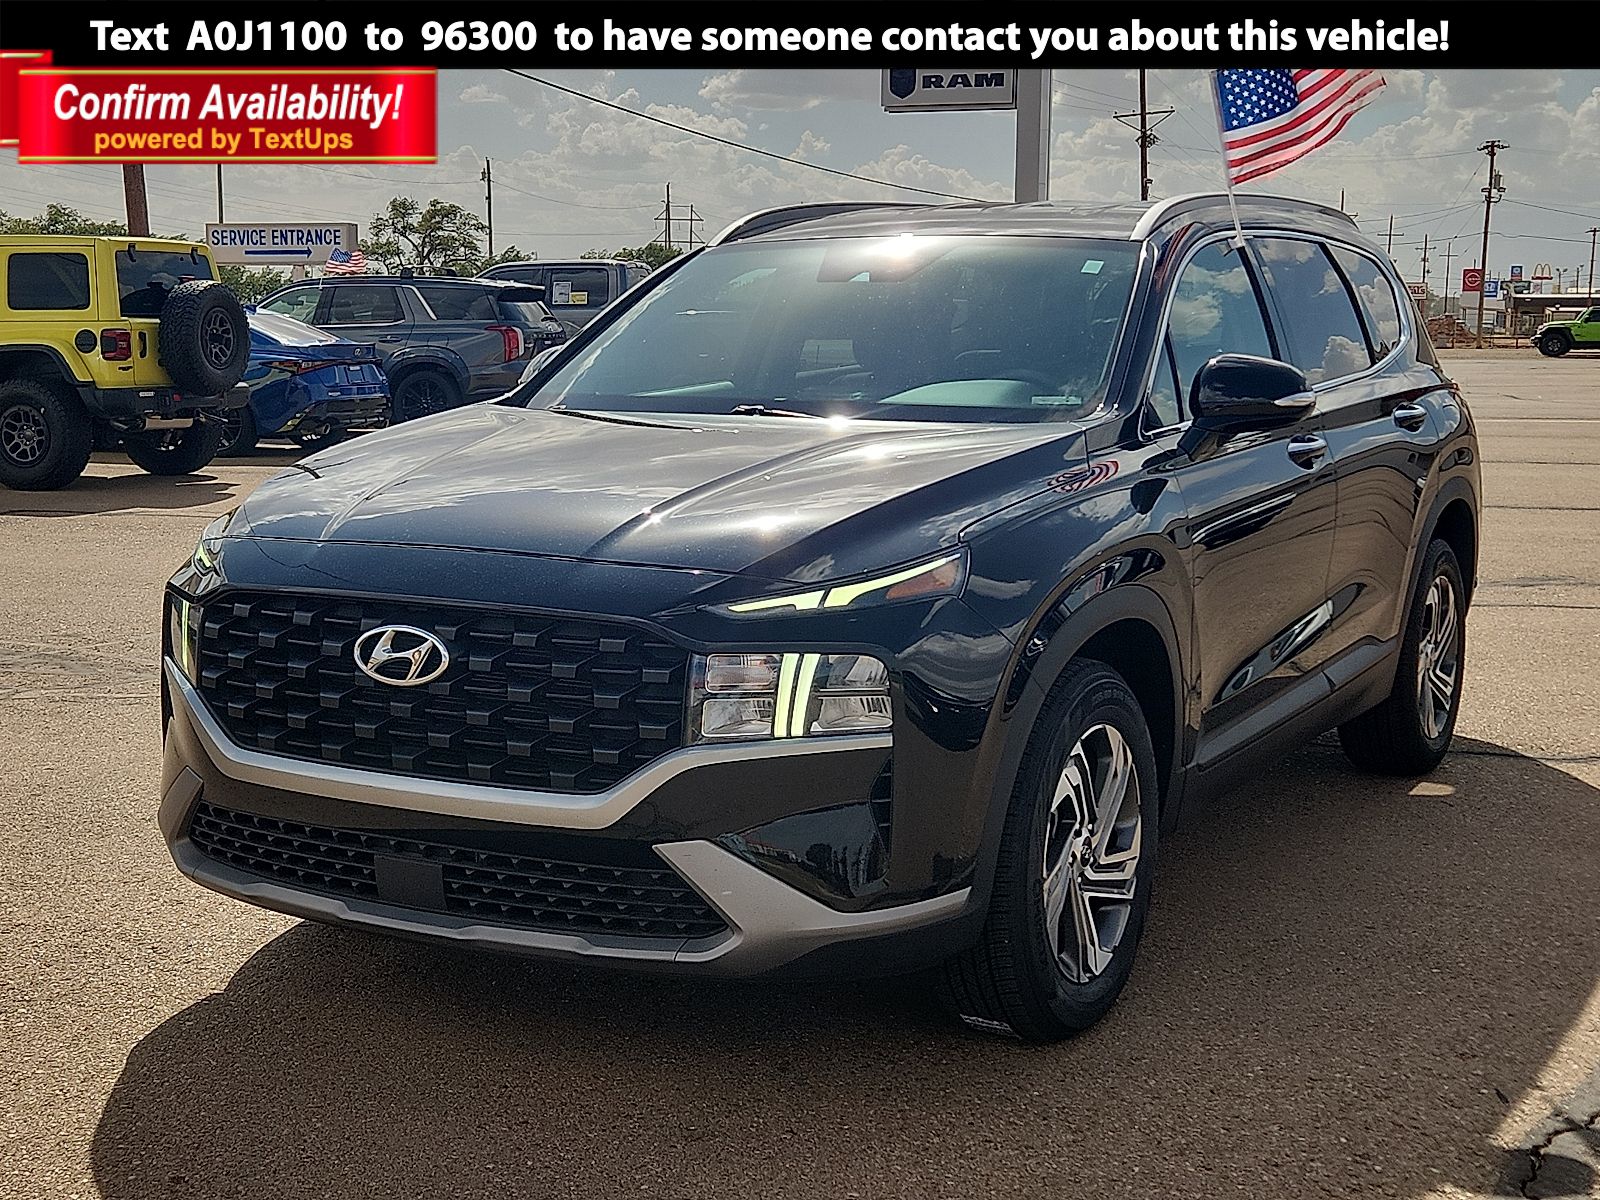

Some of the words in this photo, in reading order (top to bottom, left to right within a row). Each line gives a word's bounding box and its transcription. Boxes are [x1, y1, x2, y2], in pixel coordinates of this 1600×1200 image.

[921, 73, 1005, 89] RAM
[211, 229, 267, 246] SERVICE
[271, 229, 342, 246] ENTRANCE
